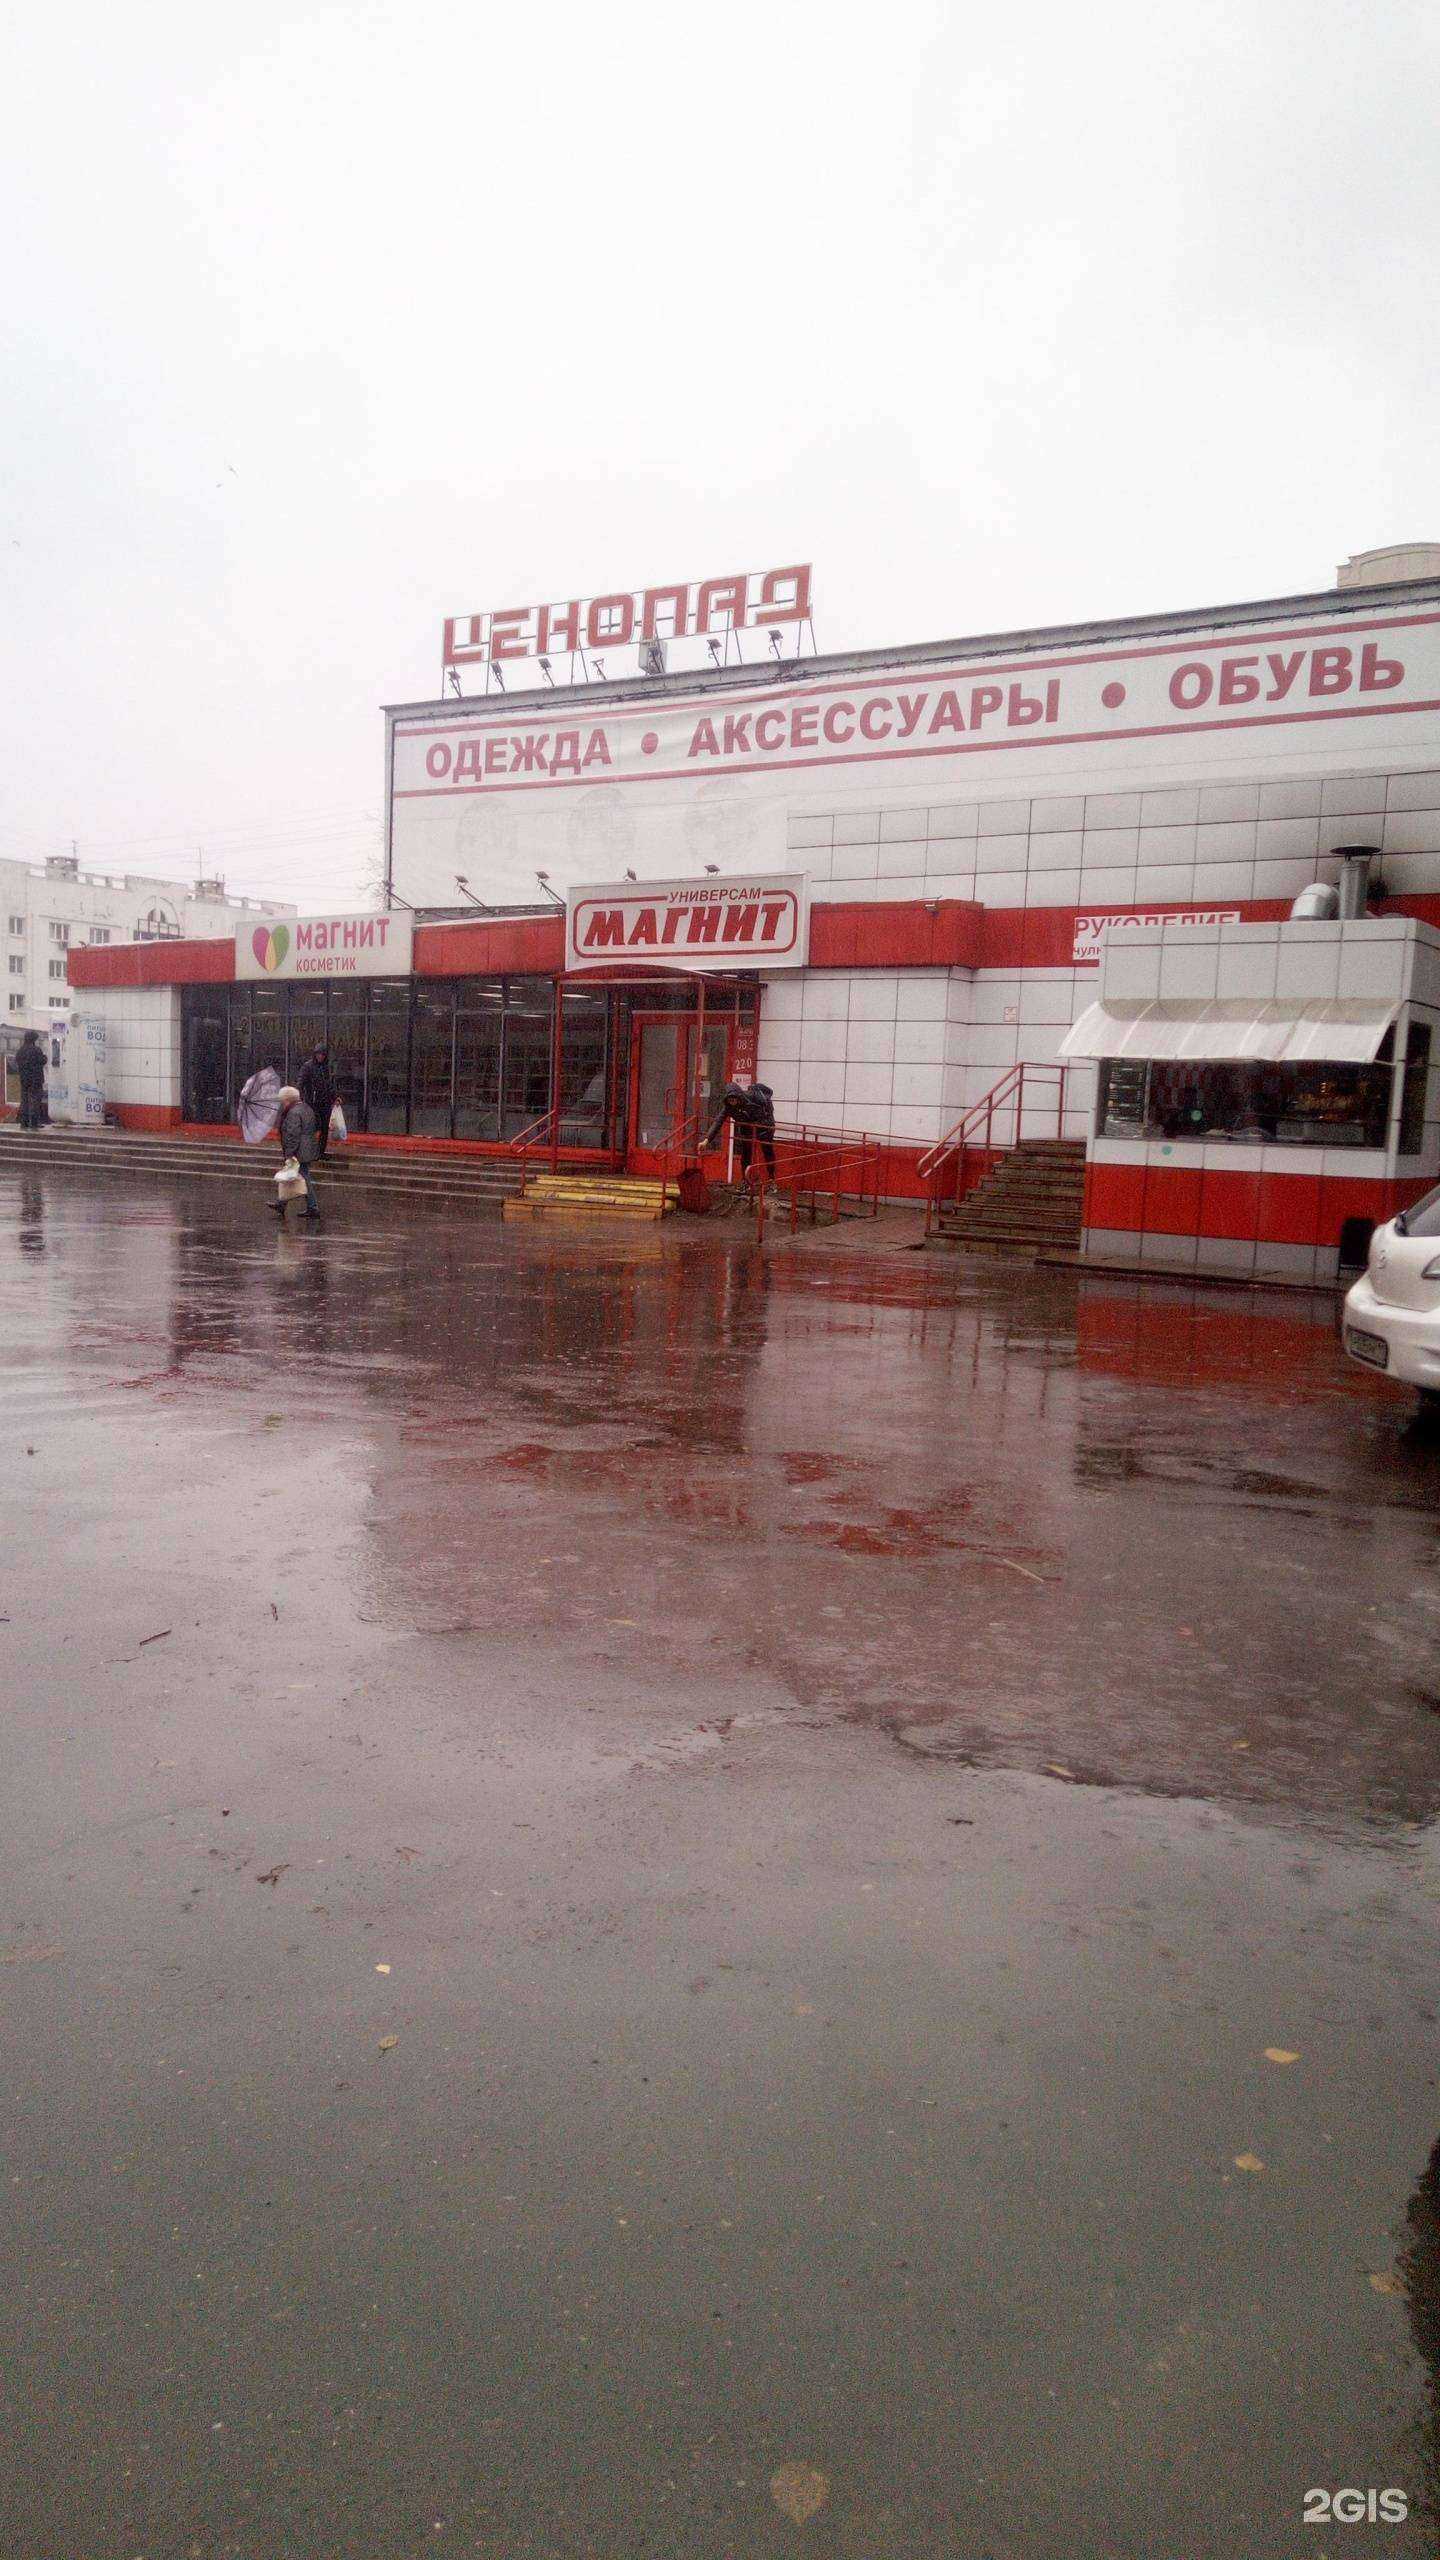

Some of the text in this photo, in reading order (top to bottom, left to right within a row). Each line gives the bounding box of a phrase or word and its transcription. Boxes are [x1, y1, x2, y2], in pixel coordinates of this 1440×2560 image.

[441, 562, 813, 668] ЦЕНОПАД
[425, 642, 1405, 784] ОДЕЖДА АКСЕССУАРЫ ОБУВЬ
[582, 901, 788, 947] МАГНИТ
[668, 887, 762, 904] УНИВЕРСАМ
